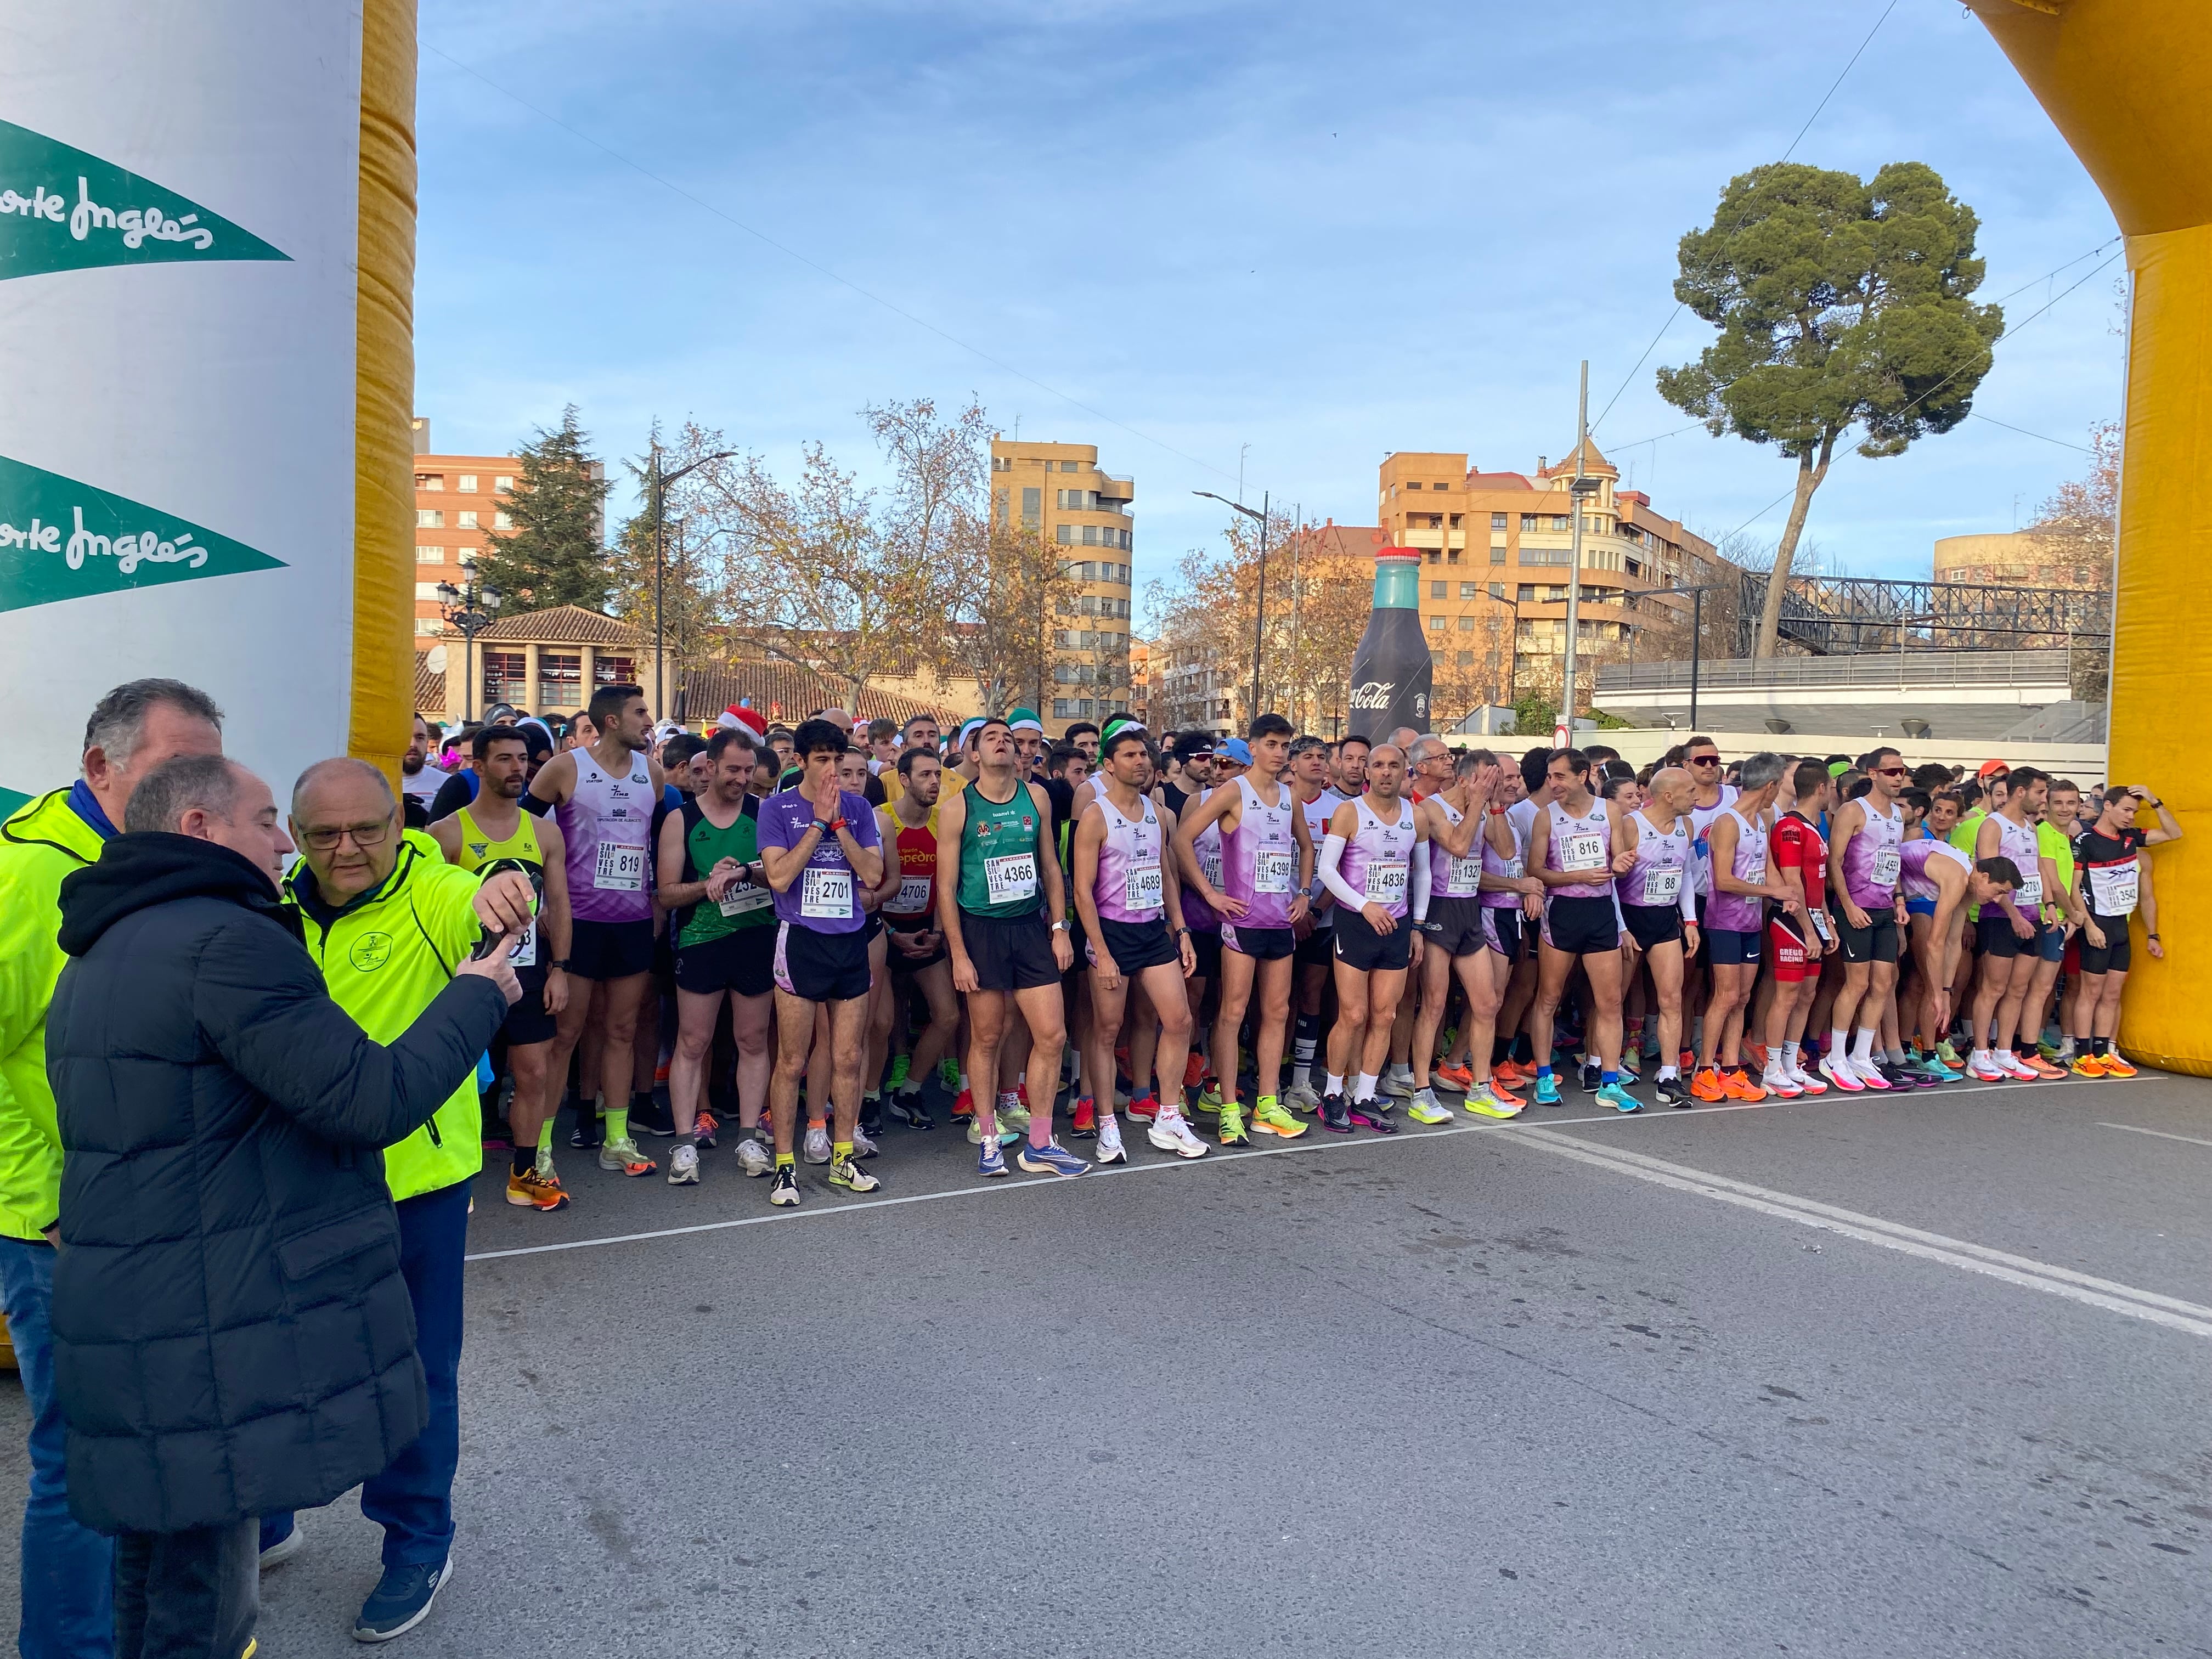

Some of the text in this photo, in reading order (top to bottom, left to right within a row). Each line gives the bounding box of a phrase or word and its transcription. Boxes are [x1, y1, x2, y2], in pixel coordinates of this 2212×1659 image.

[0, 176, 213, 249] orte Inglés
[0, 506, 208, 574] orte Inglés
[1579, 841, 1599, 855] 816
[620, 855, 639, 872] 819
[1271, 861, 1289, 876] 4398
[1005, 865, 1032, 883] 4366
[1382, 873, 1404, 887] 4836
[1141, 874, 1160, 891] 4689
[1664, 877, 1675, 889] 88
[2025, 881, 2040, 893] 2781
[822, 882, 849, 899] 2701
[901, 885, 927, 899] 4706
[721, 894, 734, 903] RE
[1780, 948, 1803, 956] GREGO
